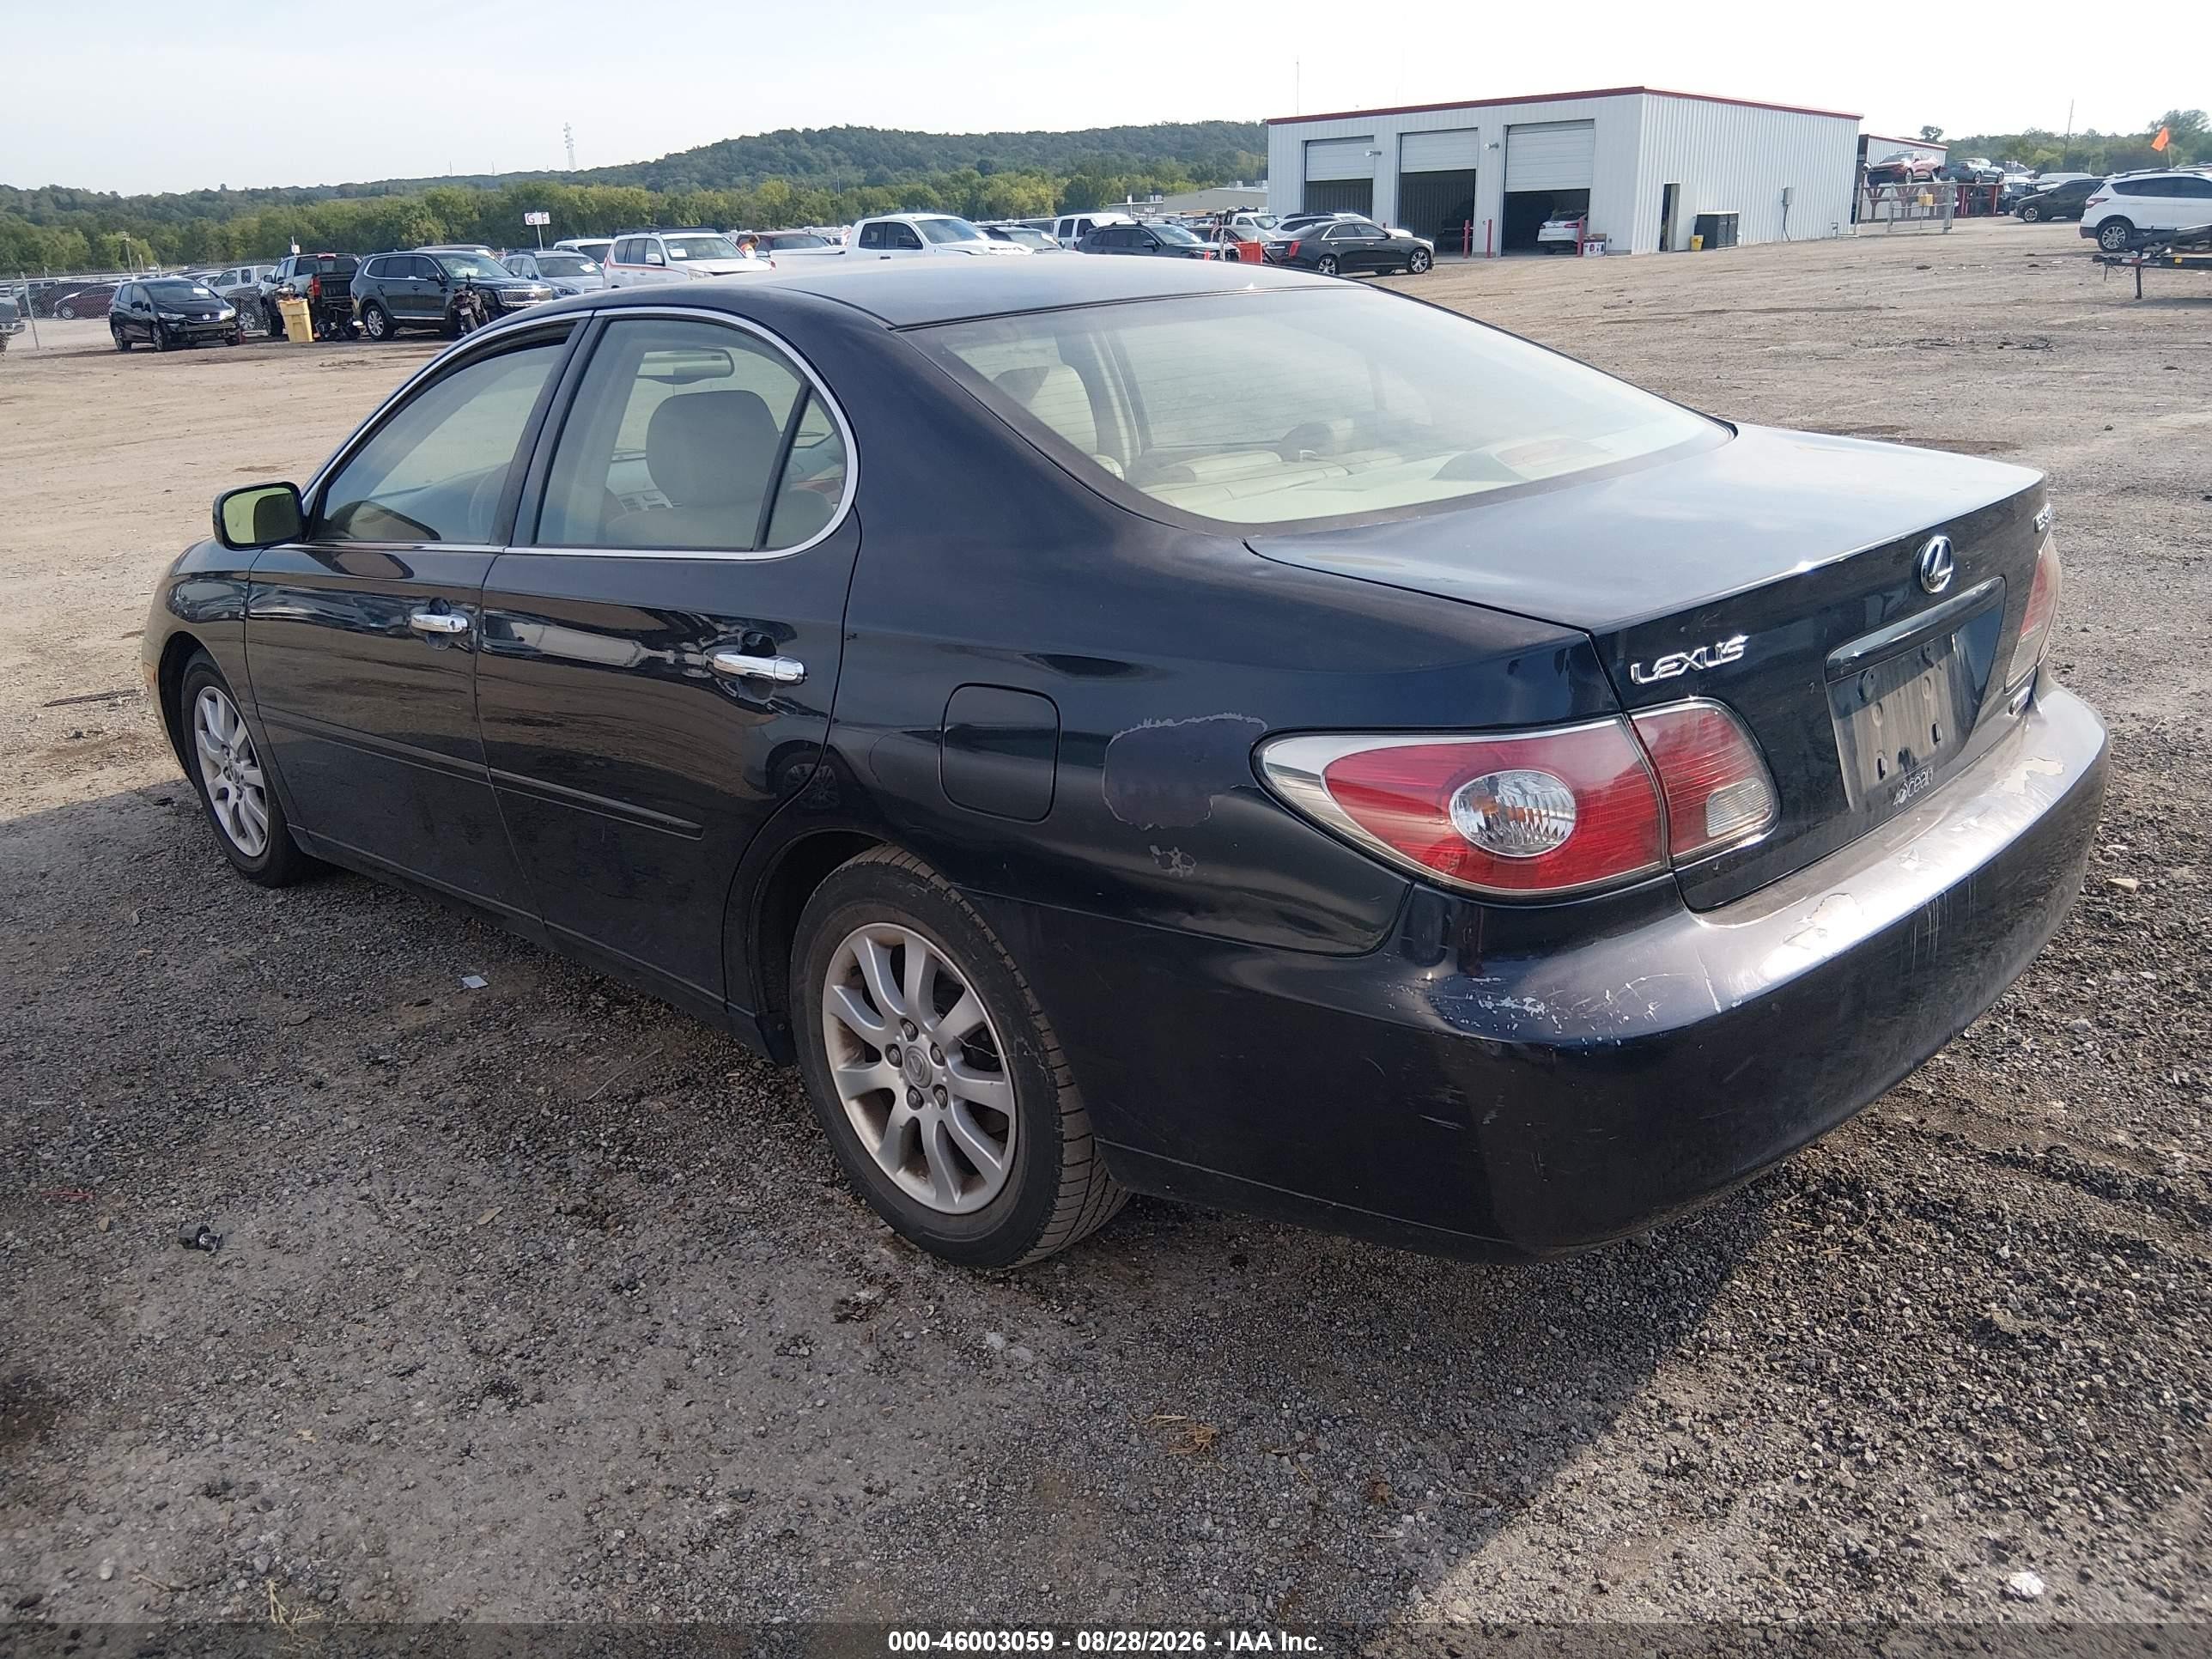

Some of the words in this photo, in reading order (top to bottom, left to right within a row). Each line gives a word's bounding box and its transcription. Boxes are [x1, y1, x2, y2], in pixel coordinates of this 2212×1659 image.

[526, 213, 535, 224] G
[541, 212, 547, 224] F
[1631, 635, 1749, 685] LEXUS
